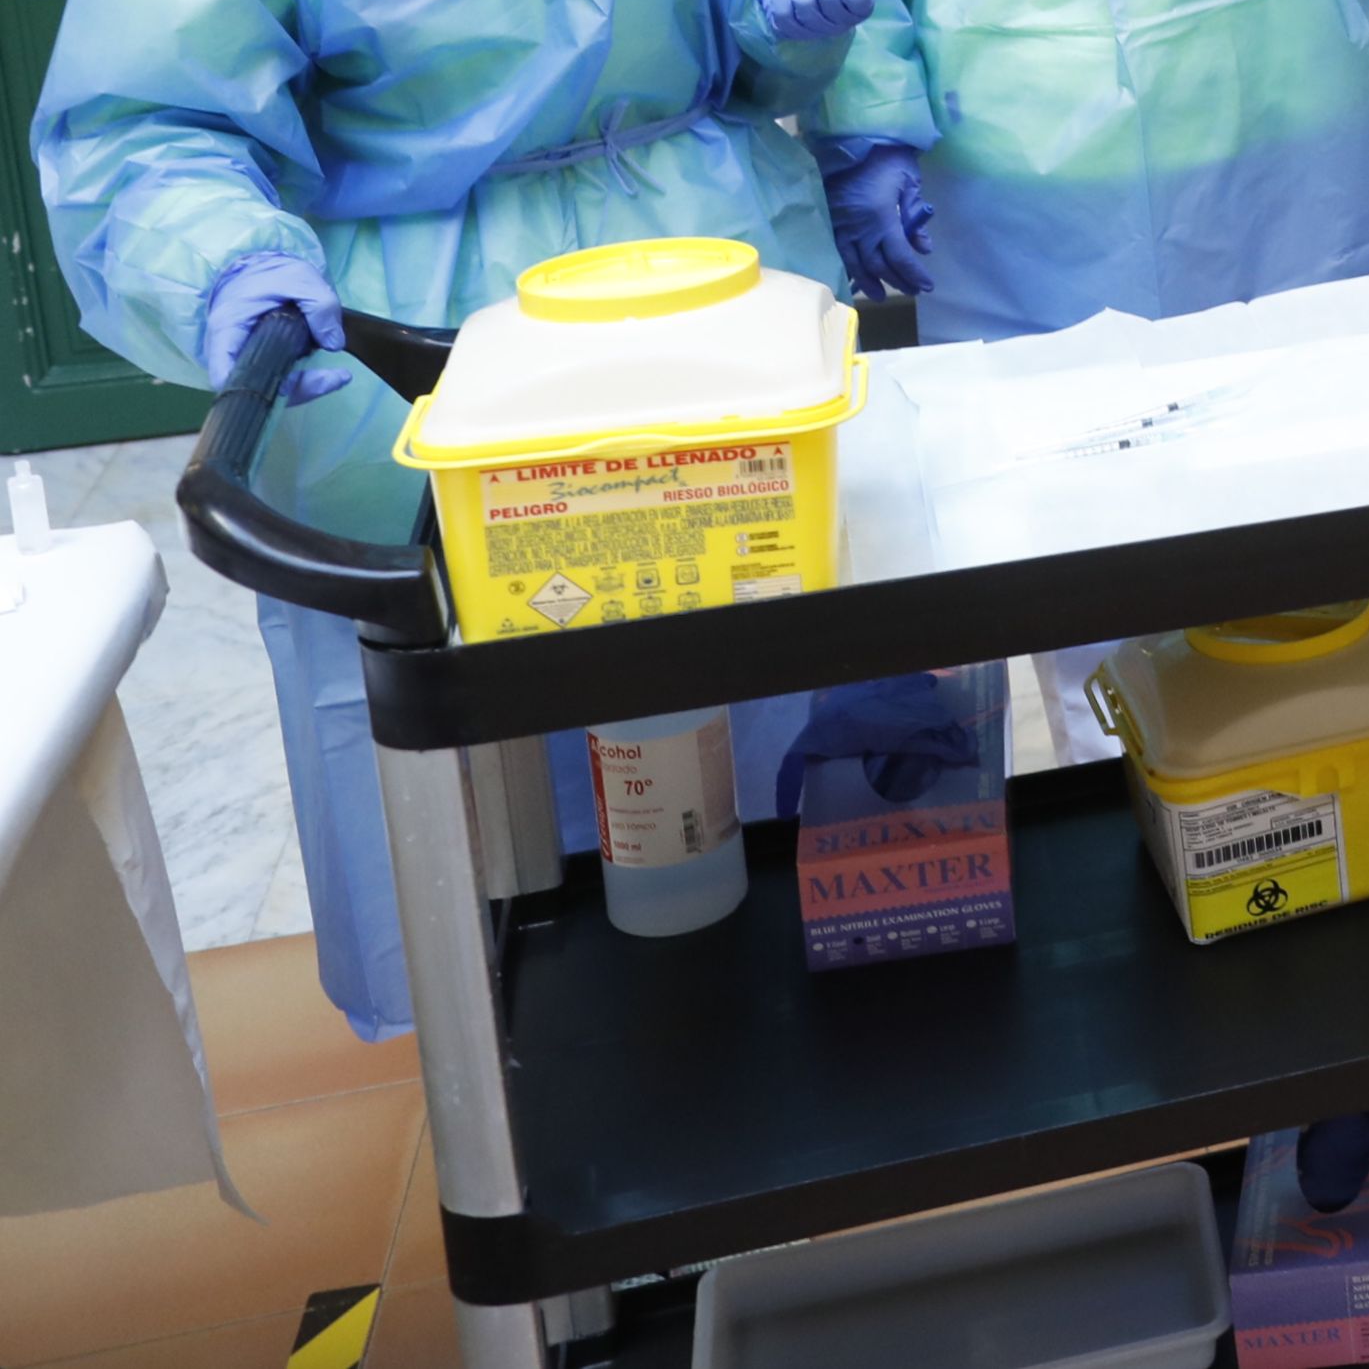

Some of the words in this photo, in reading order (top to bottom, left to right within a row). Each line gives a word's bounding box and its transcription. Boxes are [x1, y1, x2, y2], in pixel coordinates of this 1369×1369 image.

[605, 458, 638, 473] DE
[646, 446, 757, 469] LLENADO
[662, 486, 713, 503] RIESGO
[489, 501, 568, 521] PELIGRO
[809, 852, 994, 904] MAXTER
[810, 924, 837, 938] BLUE
[840, 918, 881, 933] NITRILE
[882, 907, 960, 927] EXAMINATION
[961, 900, 1003, 915] GLOVES
[1243, 1327, 1342, 1351] MAXTER
